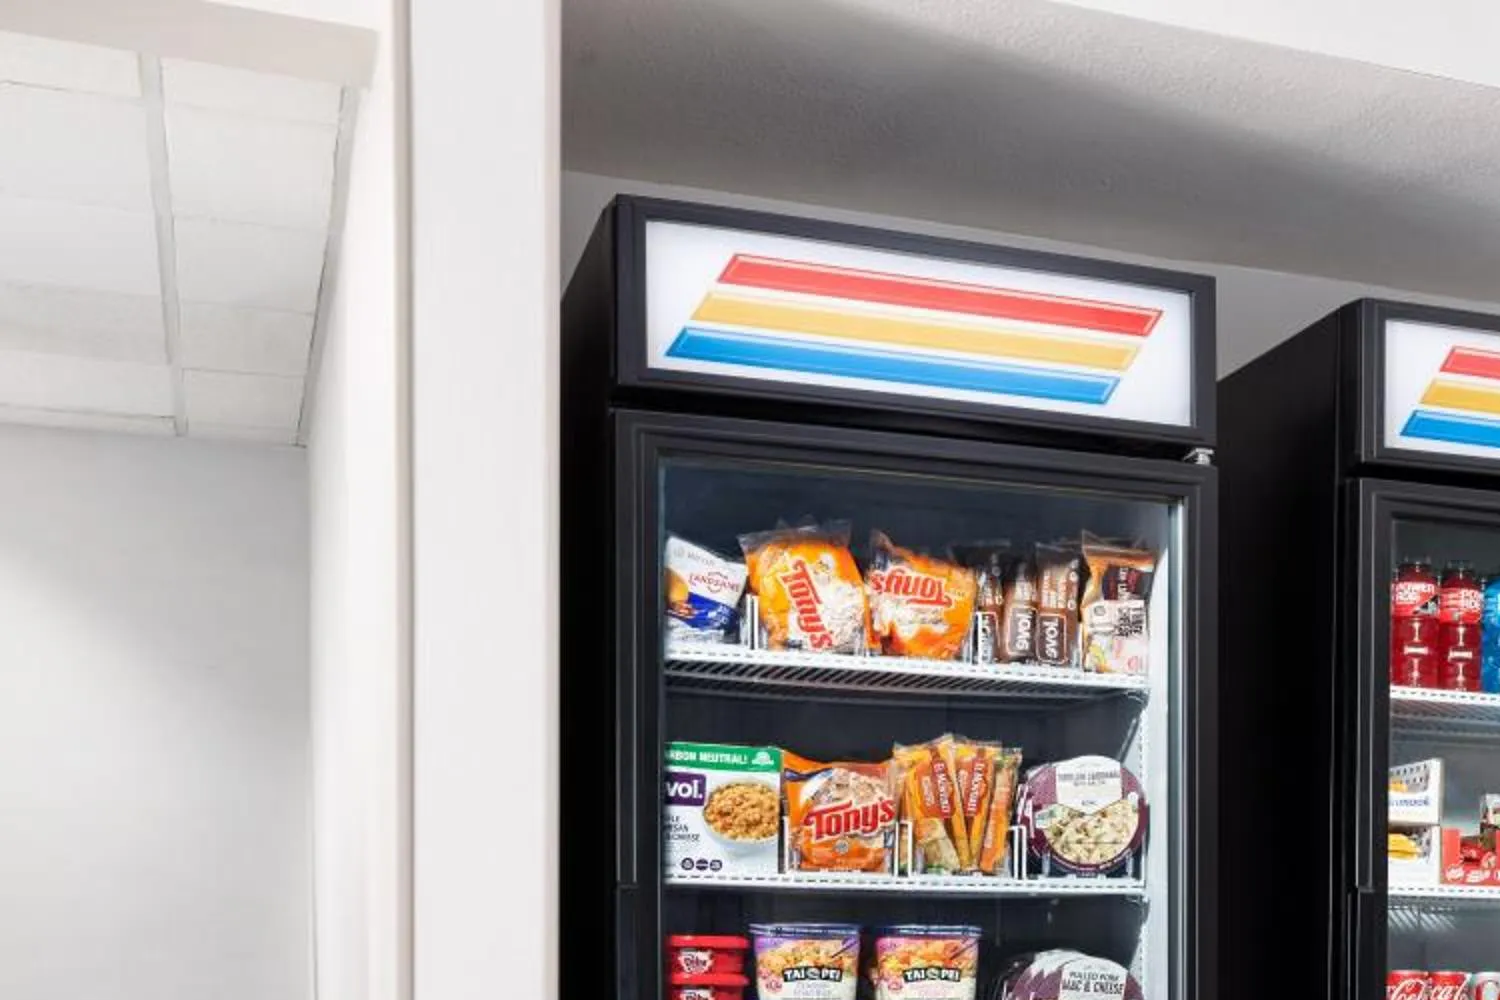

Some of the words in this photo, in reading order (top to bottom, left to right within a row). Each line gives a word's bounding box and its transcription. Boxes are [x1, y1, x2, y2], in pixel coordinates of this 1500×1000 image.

[870, 566, 954, 607] Tony's
[779, 557, 834, 650] Tony's
[804, 798, 897, 840] Tony's
[784, 968, 806, 982] TAI
[821, 968, 840, 980] PEI
[905, 969, 925, 982] TAI
[940, 969, 960, 981] PEI
[1093, 981, 1124, 995] CHEESE
